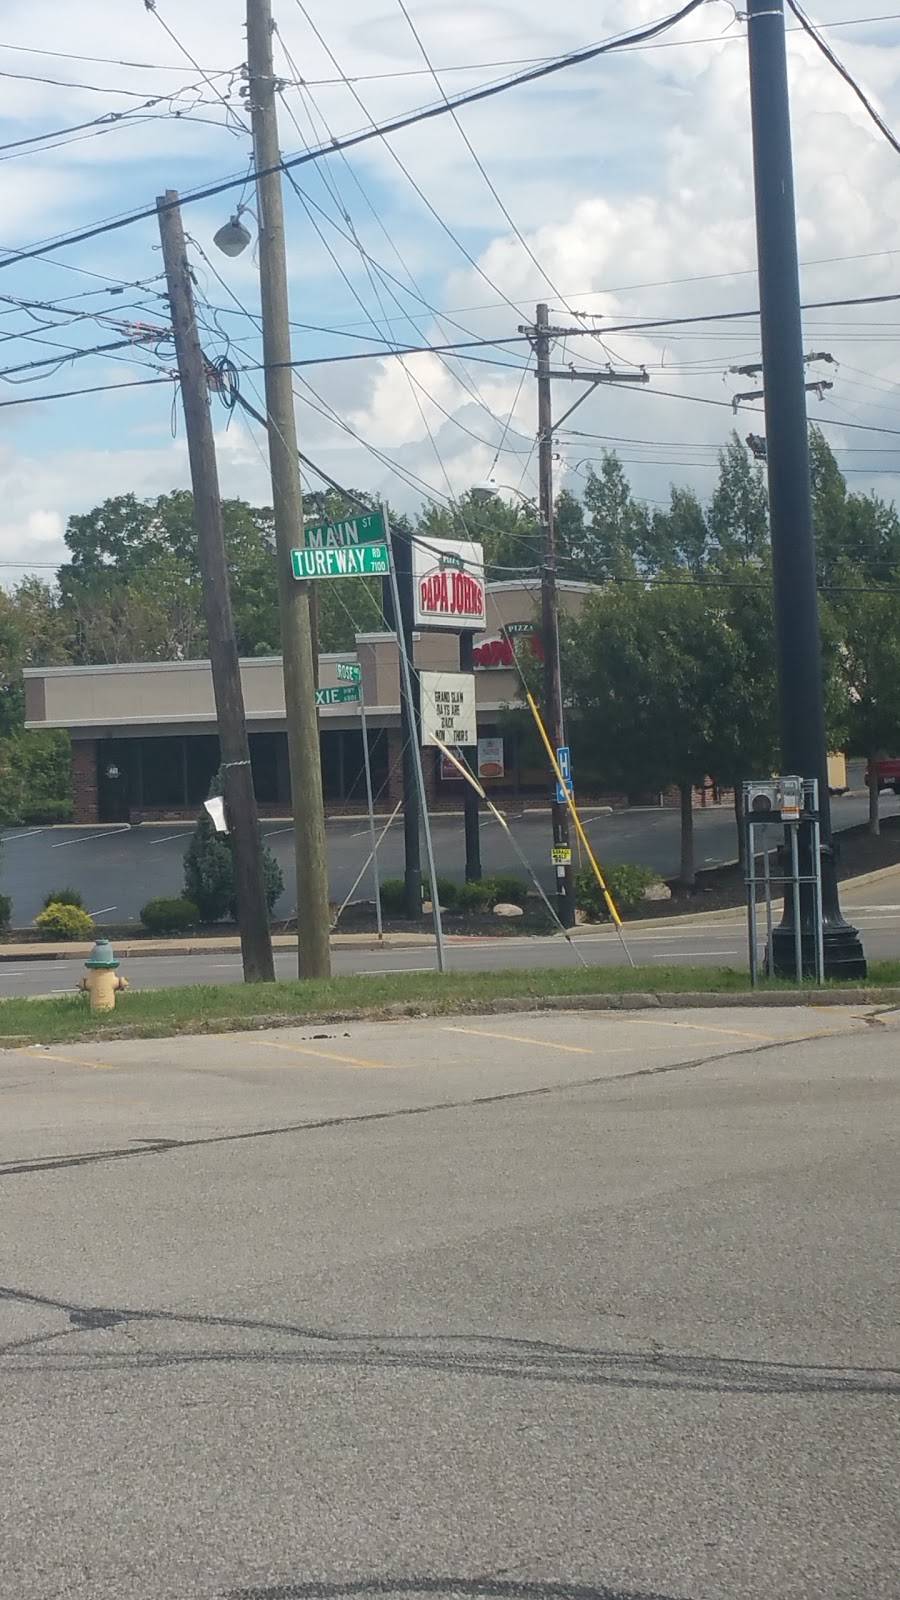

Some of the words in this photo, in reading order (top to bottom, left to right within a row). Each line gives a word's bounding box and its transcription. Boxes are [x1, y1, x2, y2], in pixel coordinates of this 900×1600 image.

[308, 520, 359, 548] MAIN
[362, 517, 371, 528] ST
[295, 548, 365, 575] TURFWAY
[371, 548, 381, 558] RD
[370, 561, 386, 572] 7100
[421, 573, 449, 612] PAPA
[508, 624, 534, 633] PIZZA
[337, 664, 353, 680] ROSE
[316, 690, 341, 704] XIE
[434, 691, 450, 703] GRAND
[451, 704, 460, 716] ARE
[559, 752, 568, 777] H
